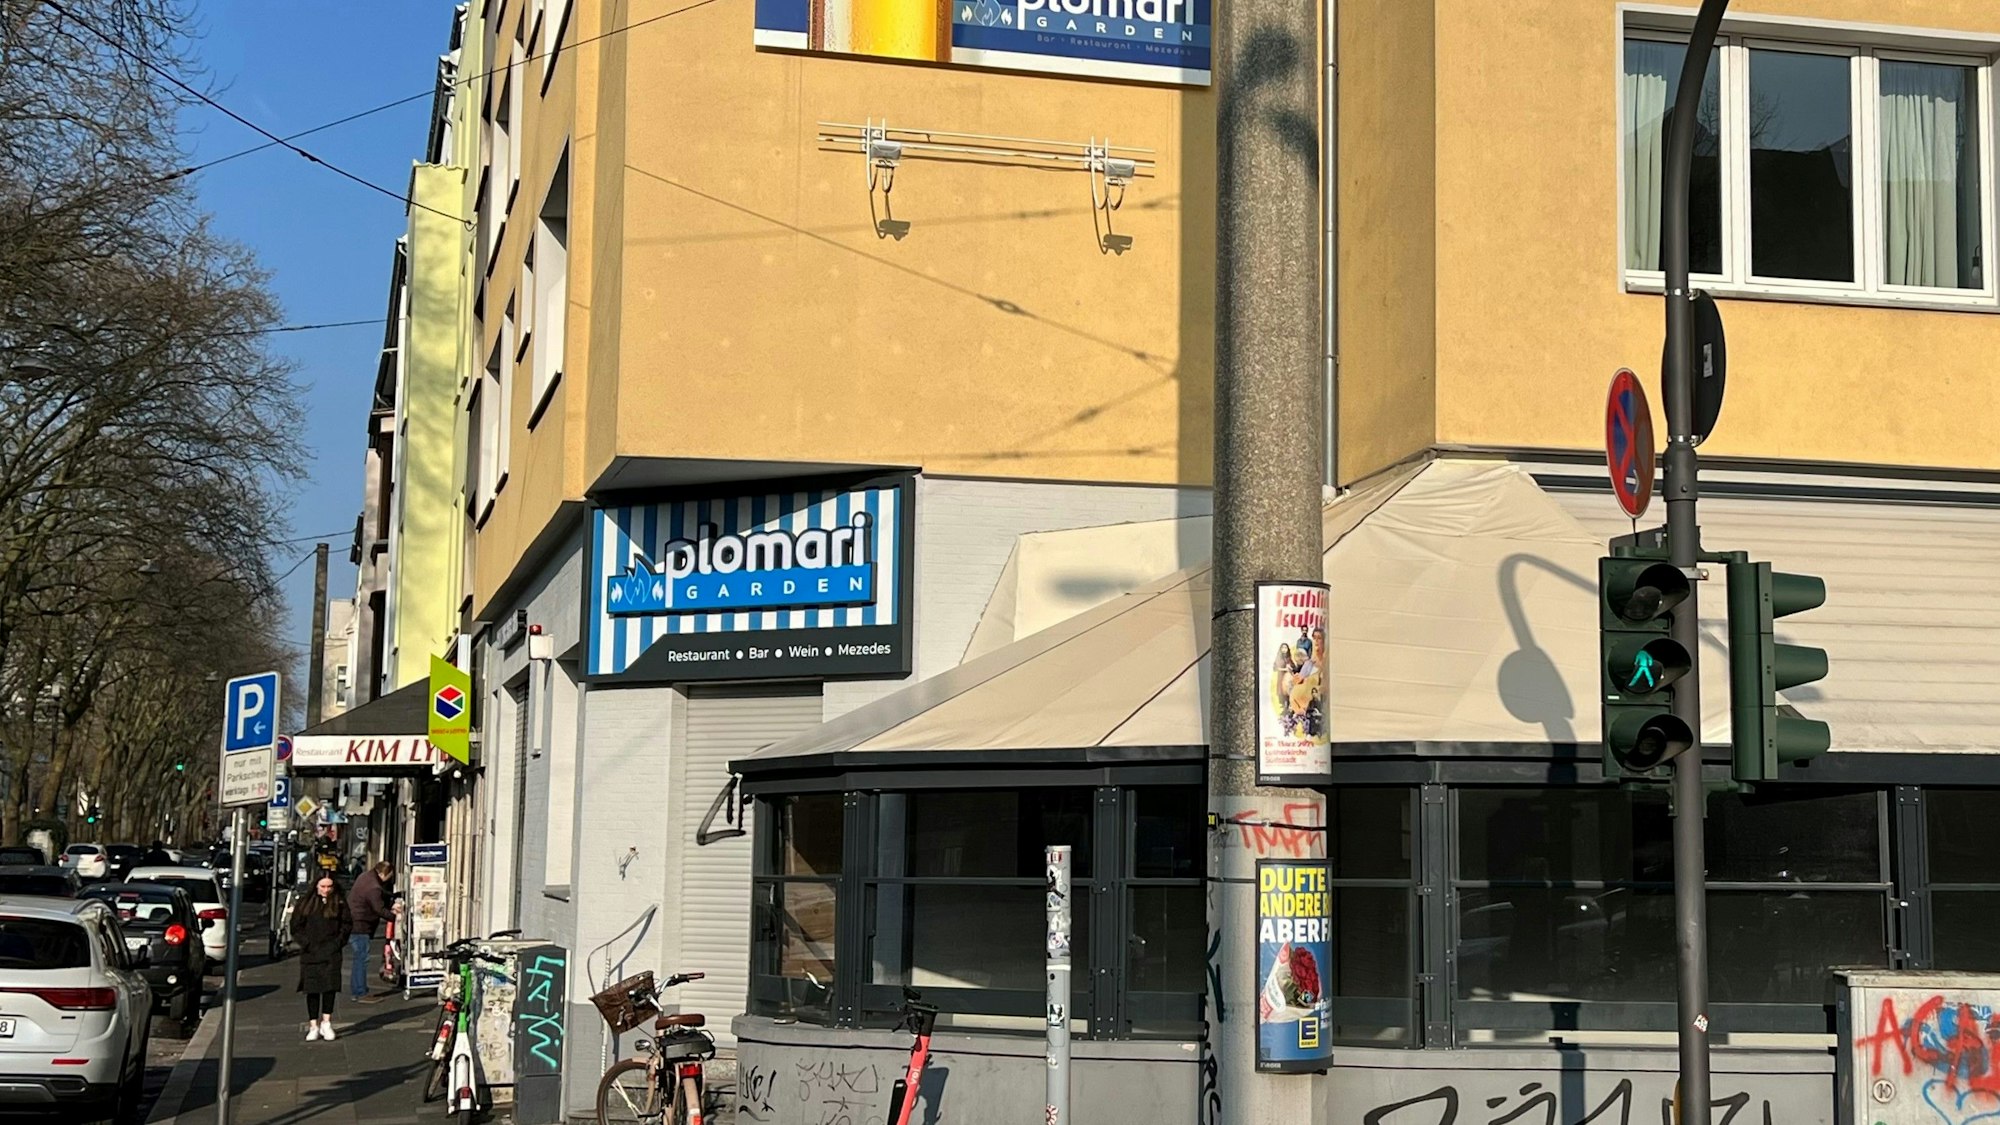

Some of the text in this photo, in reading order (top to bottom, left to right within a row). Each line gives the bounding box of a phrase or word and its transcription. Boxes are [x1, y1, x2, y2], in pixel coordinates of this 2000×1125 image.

[1036, 17, 1192, 41] GARDEN
[1036, 34, 1055, 43] Bar
[1070, 37, 1131, 50] Restaurant
[665, 511, 872, 608] plomari
[686, 576, 863, 600] GARDEN
[668, 642, 891, 662] Restaurant Bar Wein Mezedes
[236, 683, 265, 740] P
[296, 747, 342, 757] Restaurant
[345, 739, 401, 763] KIM
[226, 769, 268, 784] Parkschein
[273, 780, 286, 804] P
[1260, 867, 1326, 892] DUFTE
[1260, 892, 1321, 918] ANDERE
[1260, 918, 1320, 943] ABER
